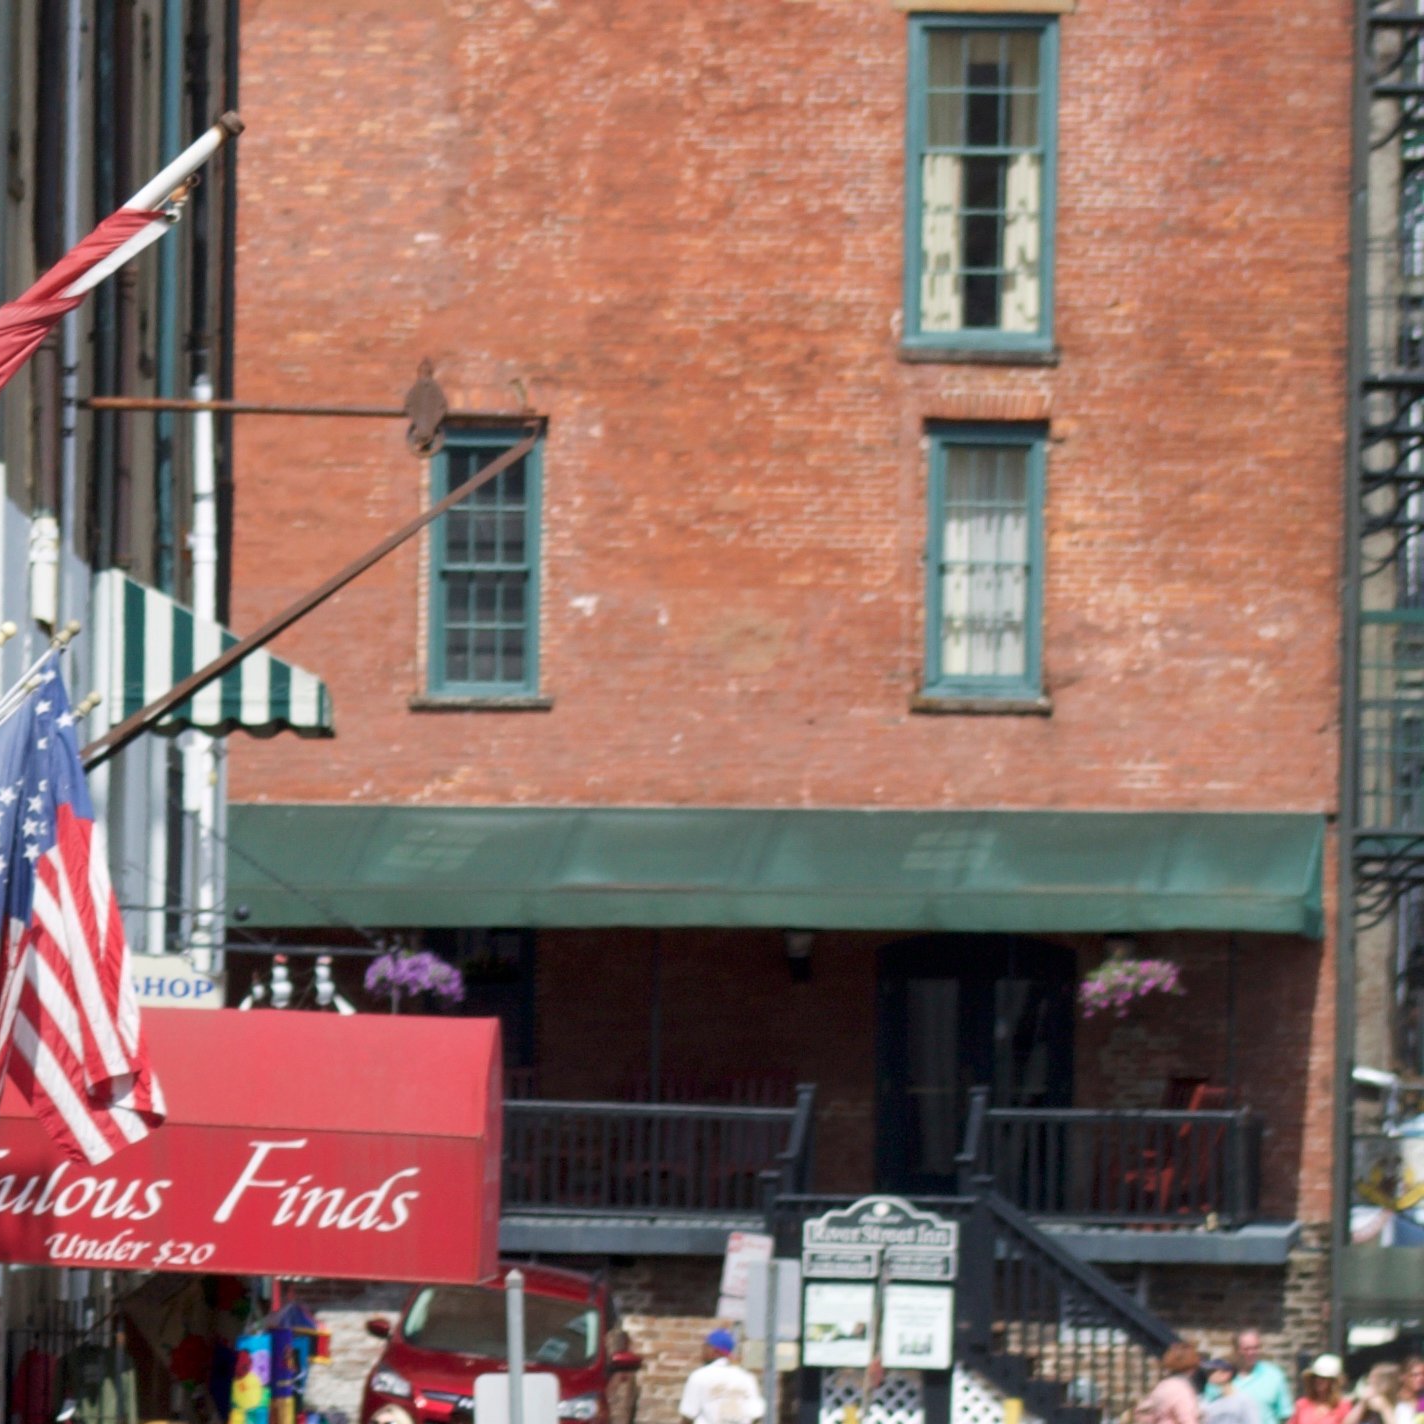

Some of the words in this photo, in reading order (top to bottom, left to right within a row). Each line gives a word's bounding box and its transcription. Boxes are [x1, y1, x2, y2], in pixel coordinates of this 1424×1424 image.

[131, 975, 215, 999] HOP
[213, 1136, 421, 1235] Finds
[45, 1231, 150, 1264] Under
[150, 1239, 217, 1268] $20
